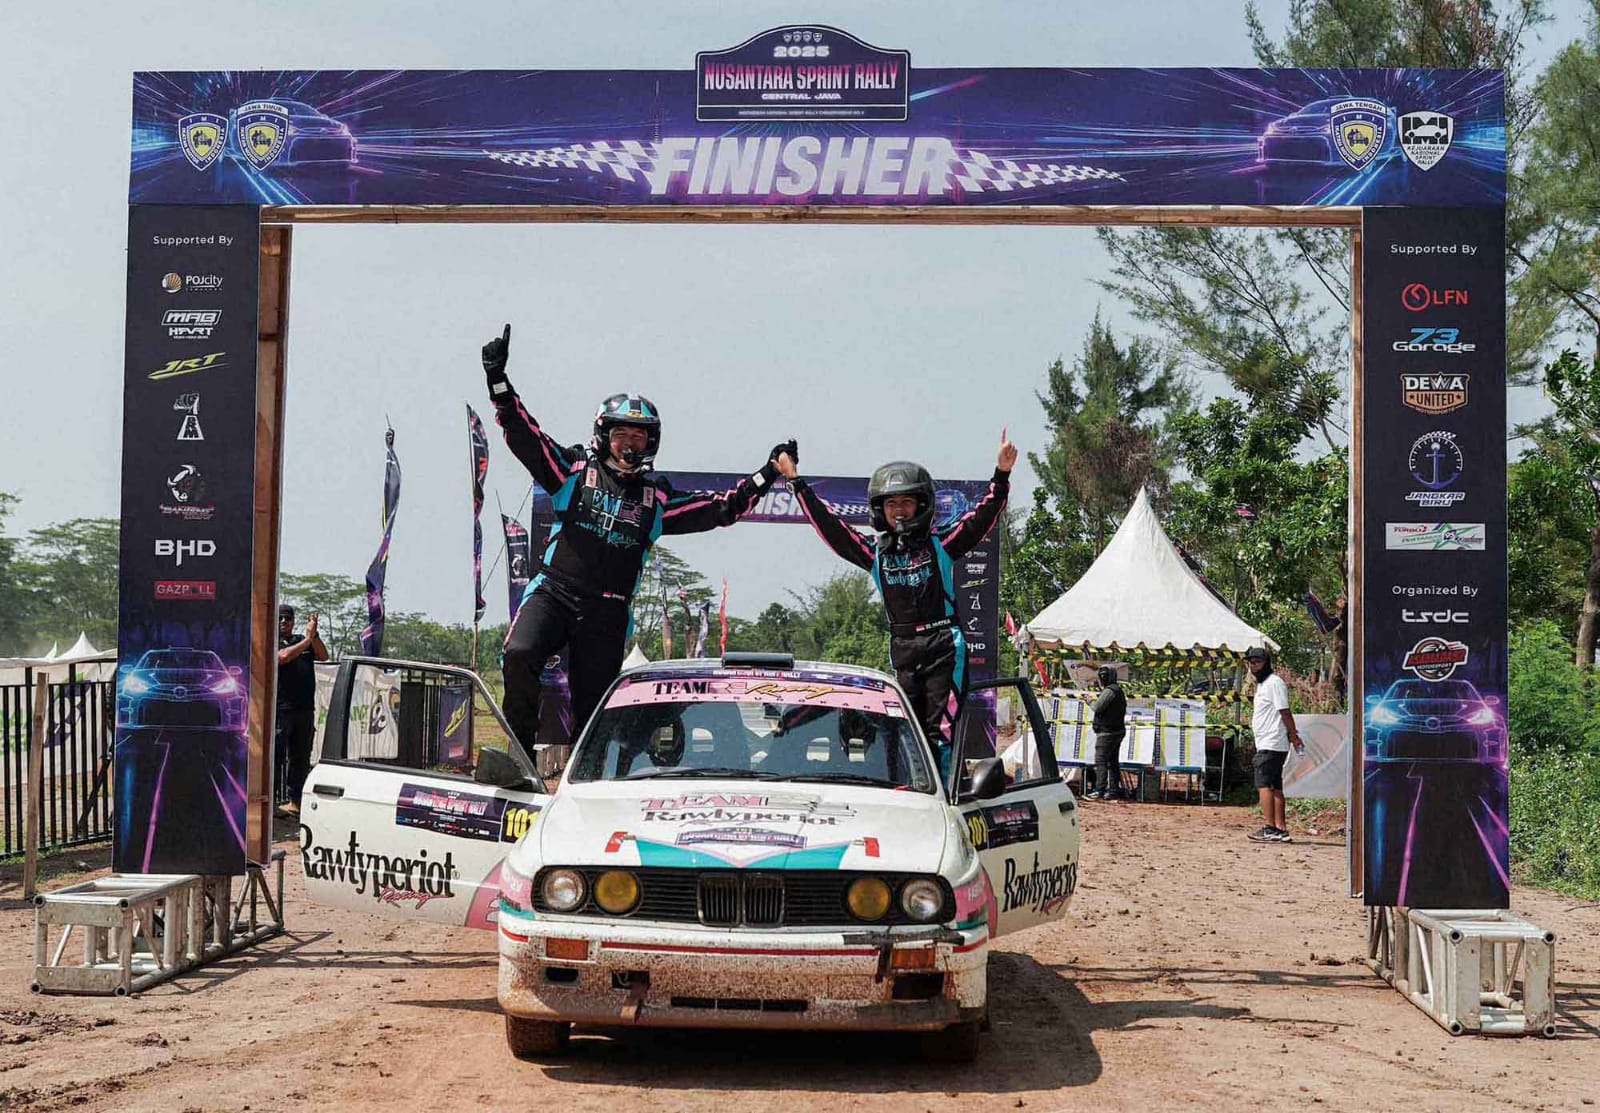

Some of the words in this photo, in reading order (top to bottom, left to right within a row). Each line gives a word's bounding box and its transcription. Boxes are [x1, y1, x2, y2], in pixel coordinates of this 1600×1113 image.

[773, 46, 830, 58] 2025
[704, 63, 794, 90] NUSANTARA
[797, 63, 851, 90] SPRINT
[854, 62, 899, 90] RALLY
[263, 103, 283, 112] TIMUR
[1335, 102, 1354, 111] JAWA
[1356, 102, 1383, 111] TENGAH
[650, 136, 952, 196] FINISHER
[153, 235, 214, 246] Supported
[218, 235, 234, 246] By
[1390, 244, 1457, 255] Supported
[1462, 244, 1478, 256] By
[1433, 290, 1468, 305] LFN
[1409, 327, 1460, 344] 73
[1392, 341, 1477, 354] Garage
[1403, 375, 1464, 390] DEWA
[1416, 393, 1455, 407] UNITED
[1405, 492, 1466, 500] JANGKAR
[154, 539, 217, 567] BHD
[1392, 585, 1458, 596] Organized
[1462, 586, 1479, 597] By
[1401, 608, 1470, 623] tsdc
[652, 681, 708, 695] TEAM
[505, 807, 539, 838] 101
[968, 816, 987, 848] 101
[300, 823, 455, 898] Rawtyperiot
[1002, 851, 1078, 914] Rawtyperio
